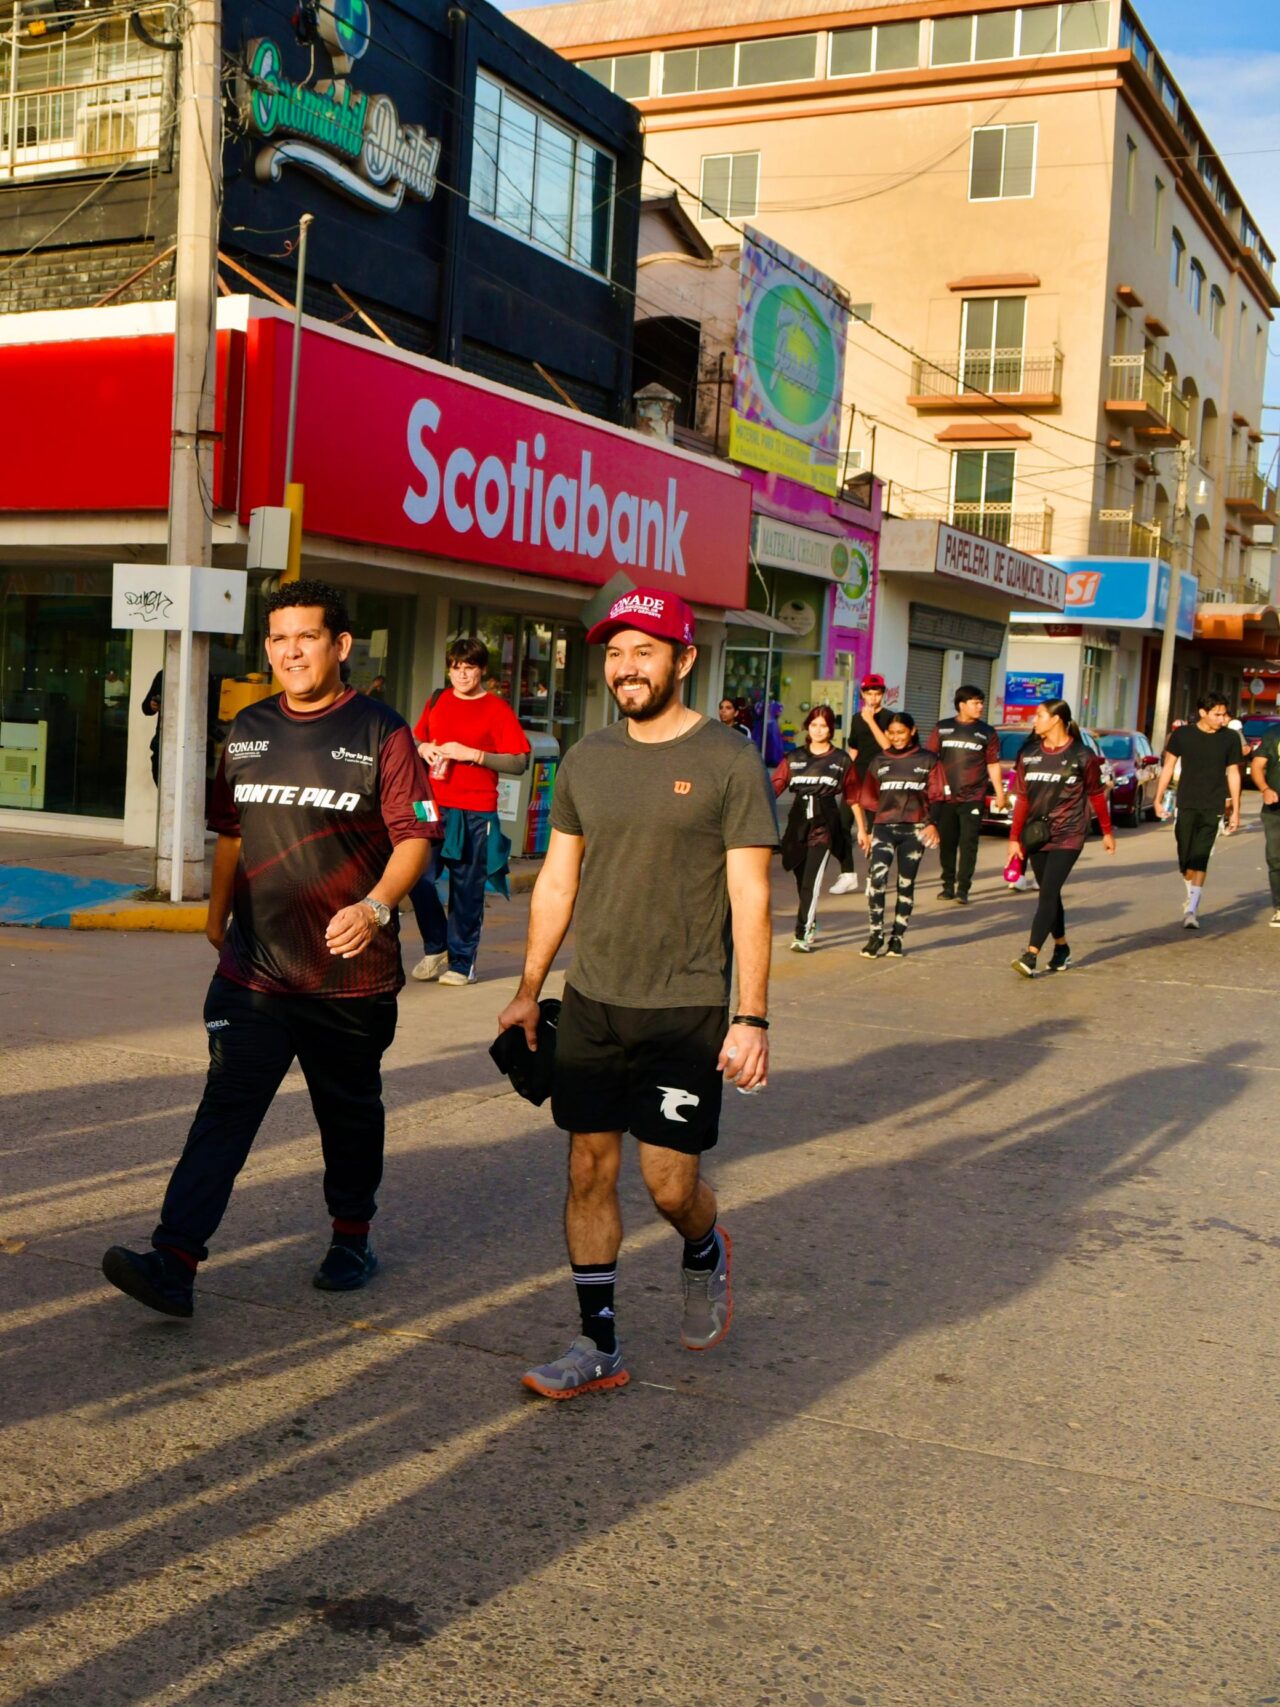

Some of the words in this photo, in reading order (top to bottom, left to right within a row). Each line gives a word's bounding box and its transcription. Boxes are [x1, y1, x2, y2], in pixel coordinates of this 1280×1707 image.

[402, 398, 689, 577] Scotiabank
[944, 533, 990, 579] PAPELERA
[993, 550, 1005, 583] DE
[1006, 555, 1045, 597] GUAMUCHIL
[228, 740, 270, 754] CONADE
[344, 751, 357, 759] Por
[356, 752, 363, 760] la
[362, 755, 374, 763] paz
[233, 783, 300, 805] PONTE
[297, 786, 361, 812] PILA
